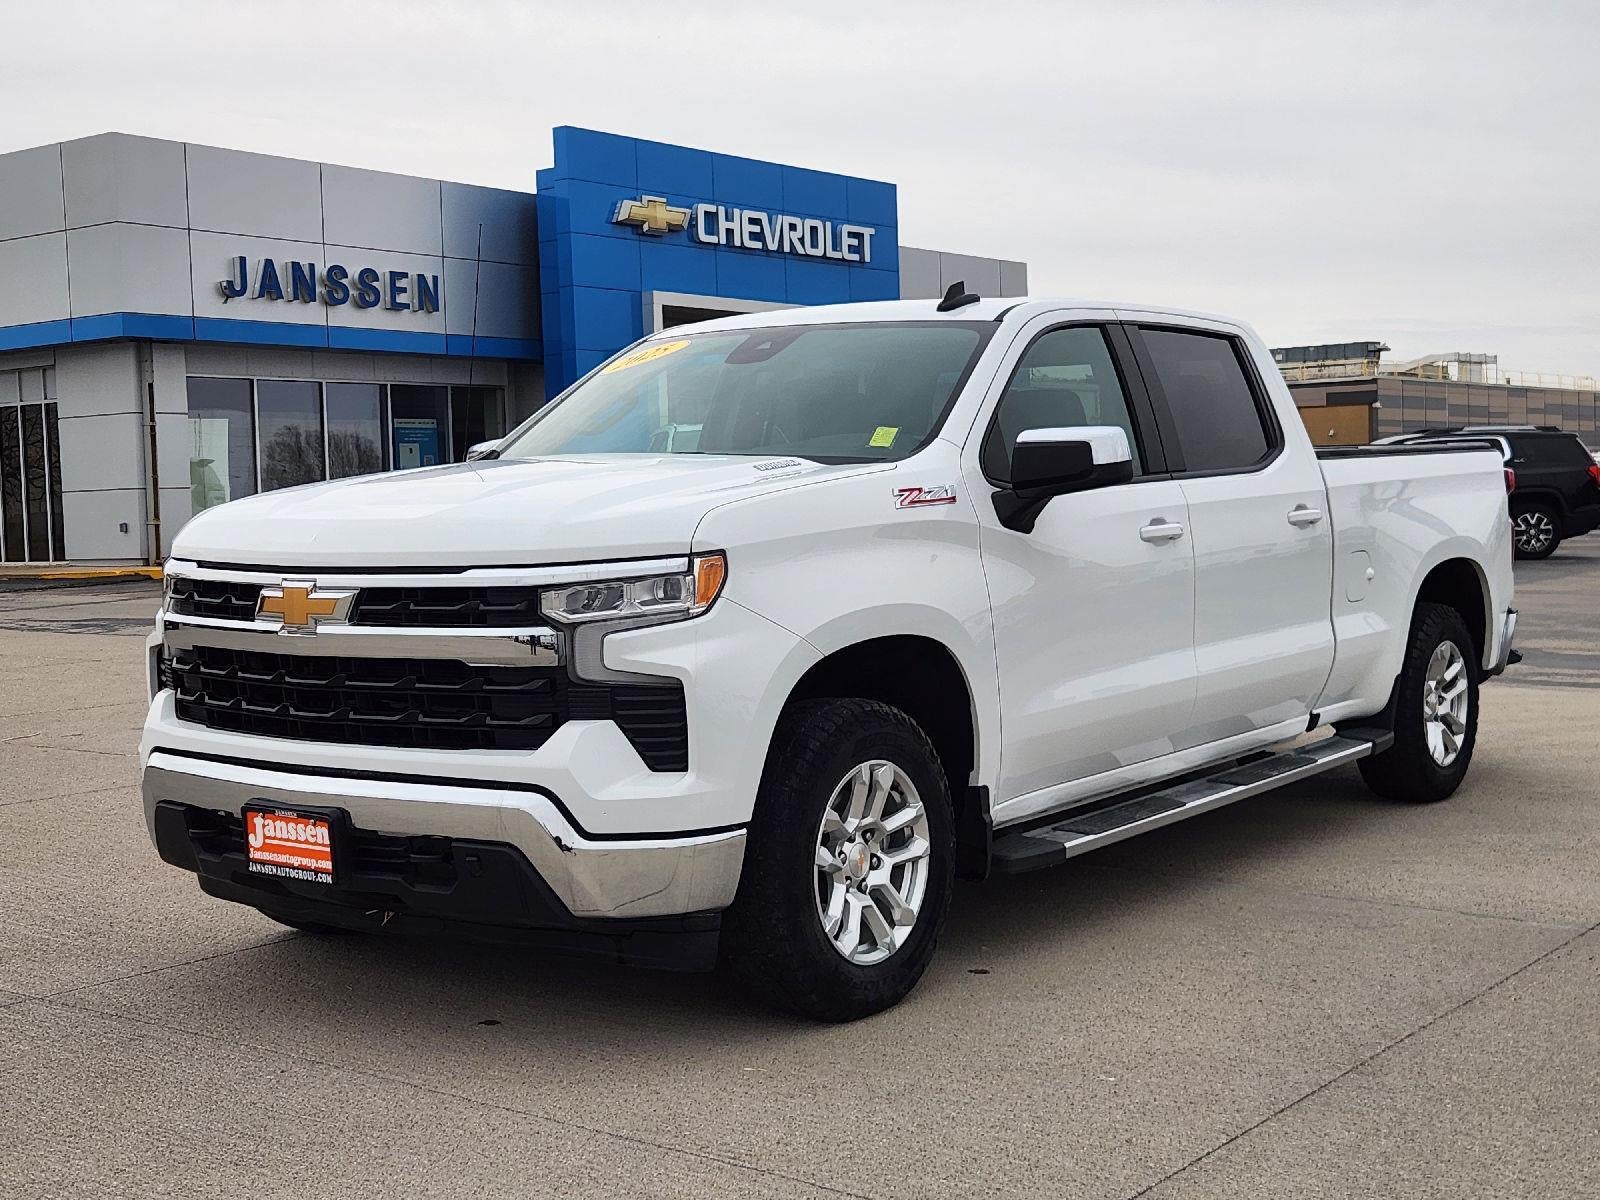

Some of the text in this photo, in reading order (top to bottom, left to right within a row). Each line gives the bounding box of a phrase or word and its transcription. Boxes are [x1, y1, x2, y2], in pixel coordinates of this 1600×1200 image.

[695, 203, 875, 263] CHEVROLET
[220, 256, 440, 313] JANSSEN
[892, 484, 957, 510] Z71
[248, 815, 330, 848] Janssen
[248, 862, 333, 884] JANSSENAUTOGROUP.COM
[249, 847, 333, 870] Janssenautogroup.com
